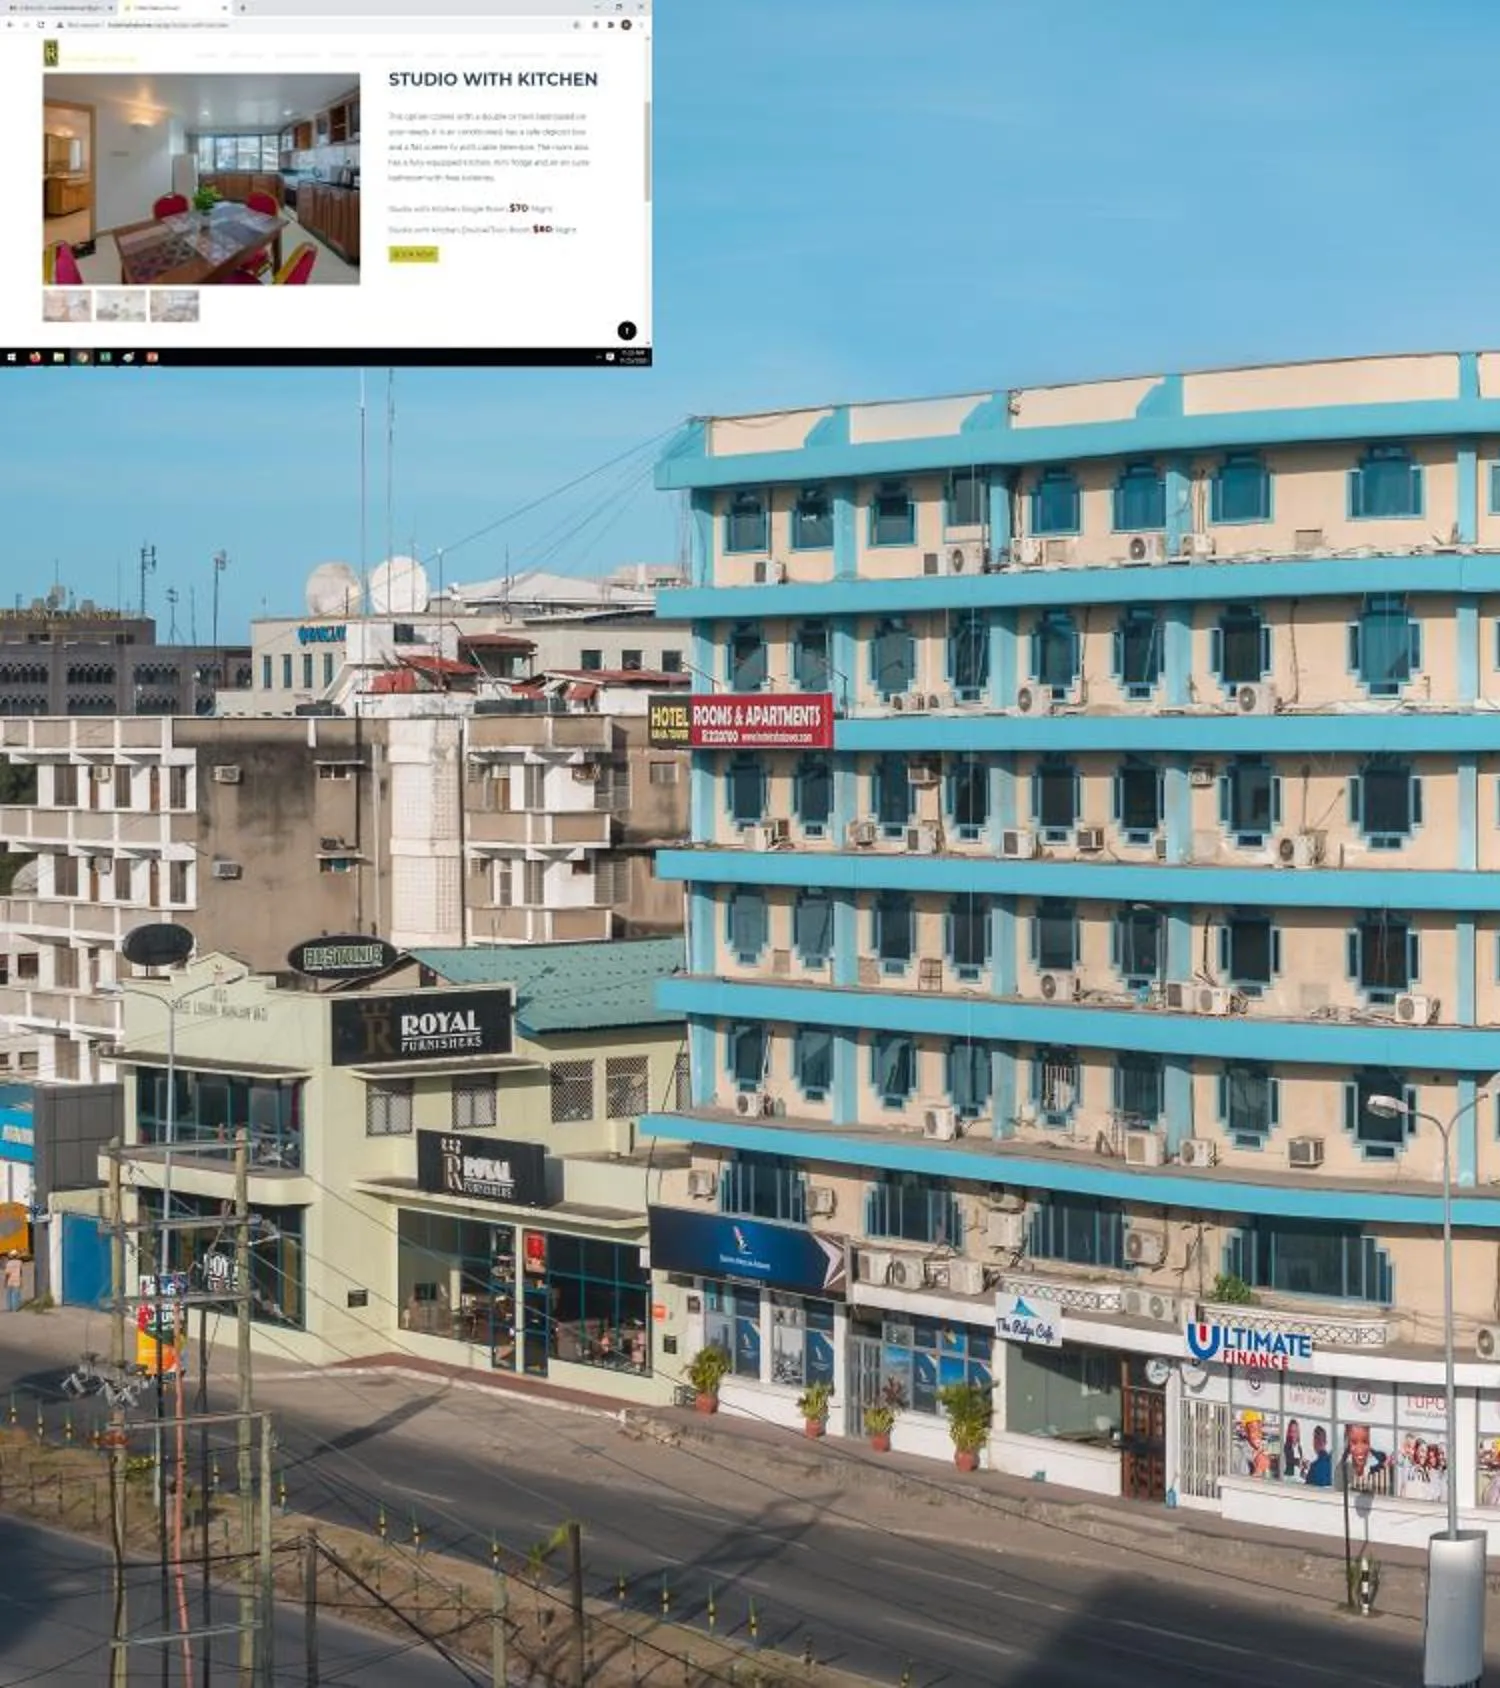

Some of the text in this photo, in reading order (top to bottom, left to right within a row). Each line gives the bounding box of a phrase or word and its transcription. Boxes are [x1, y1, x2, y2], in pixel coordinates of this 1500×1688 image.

[651, 706, 689, 728] HOTEL
[693, 705, 821, 727] ROOMS & APARTMENTS
[401, 1009, 482, 1036] ROYAL
[401, 1036, 483, 1052] FURNISHERS
[996, 1317, 1011, 1334] The
[1187, 1323, 1312, 1361] ULTIMATE
[1223, 1349, 1289, 1369] FINANCE
